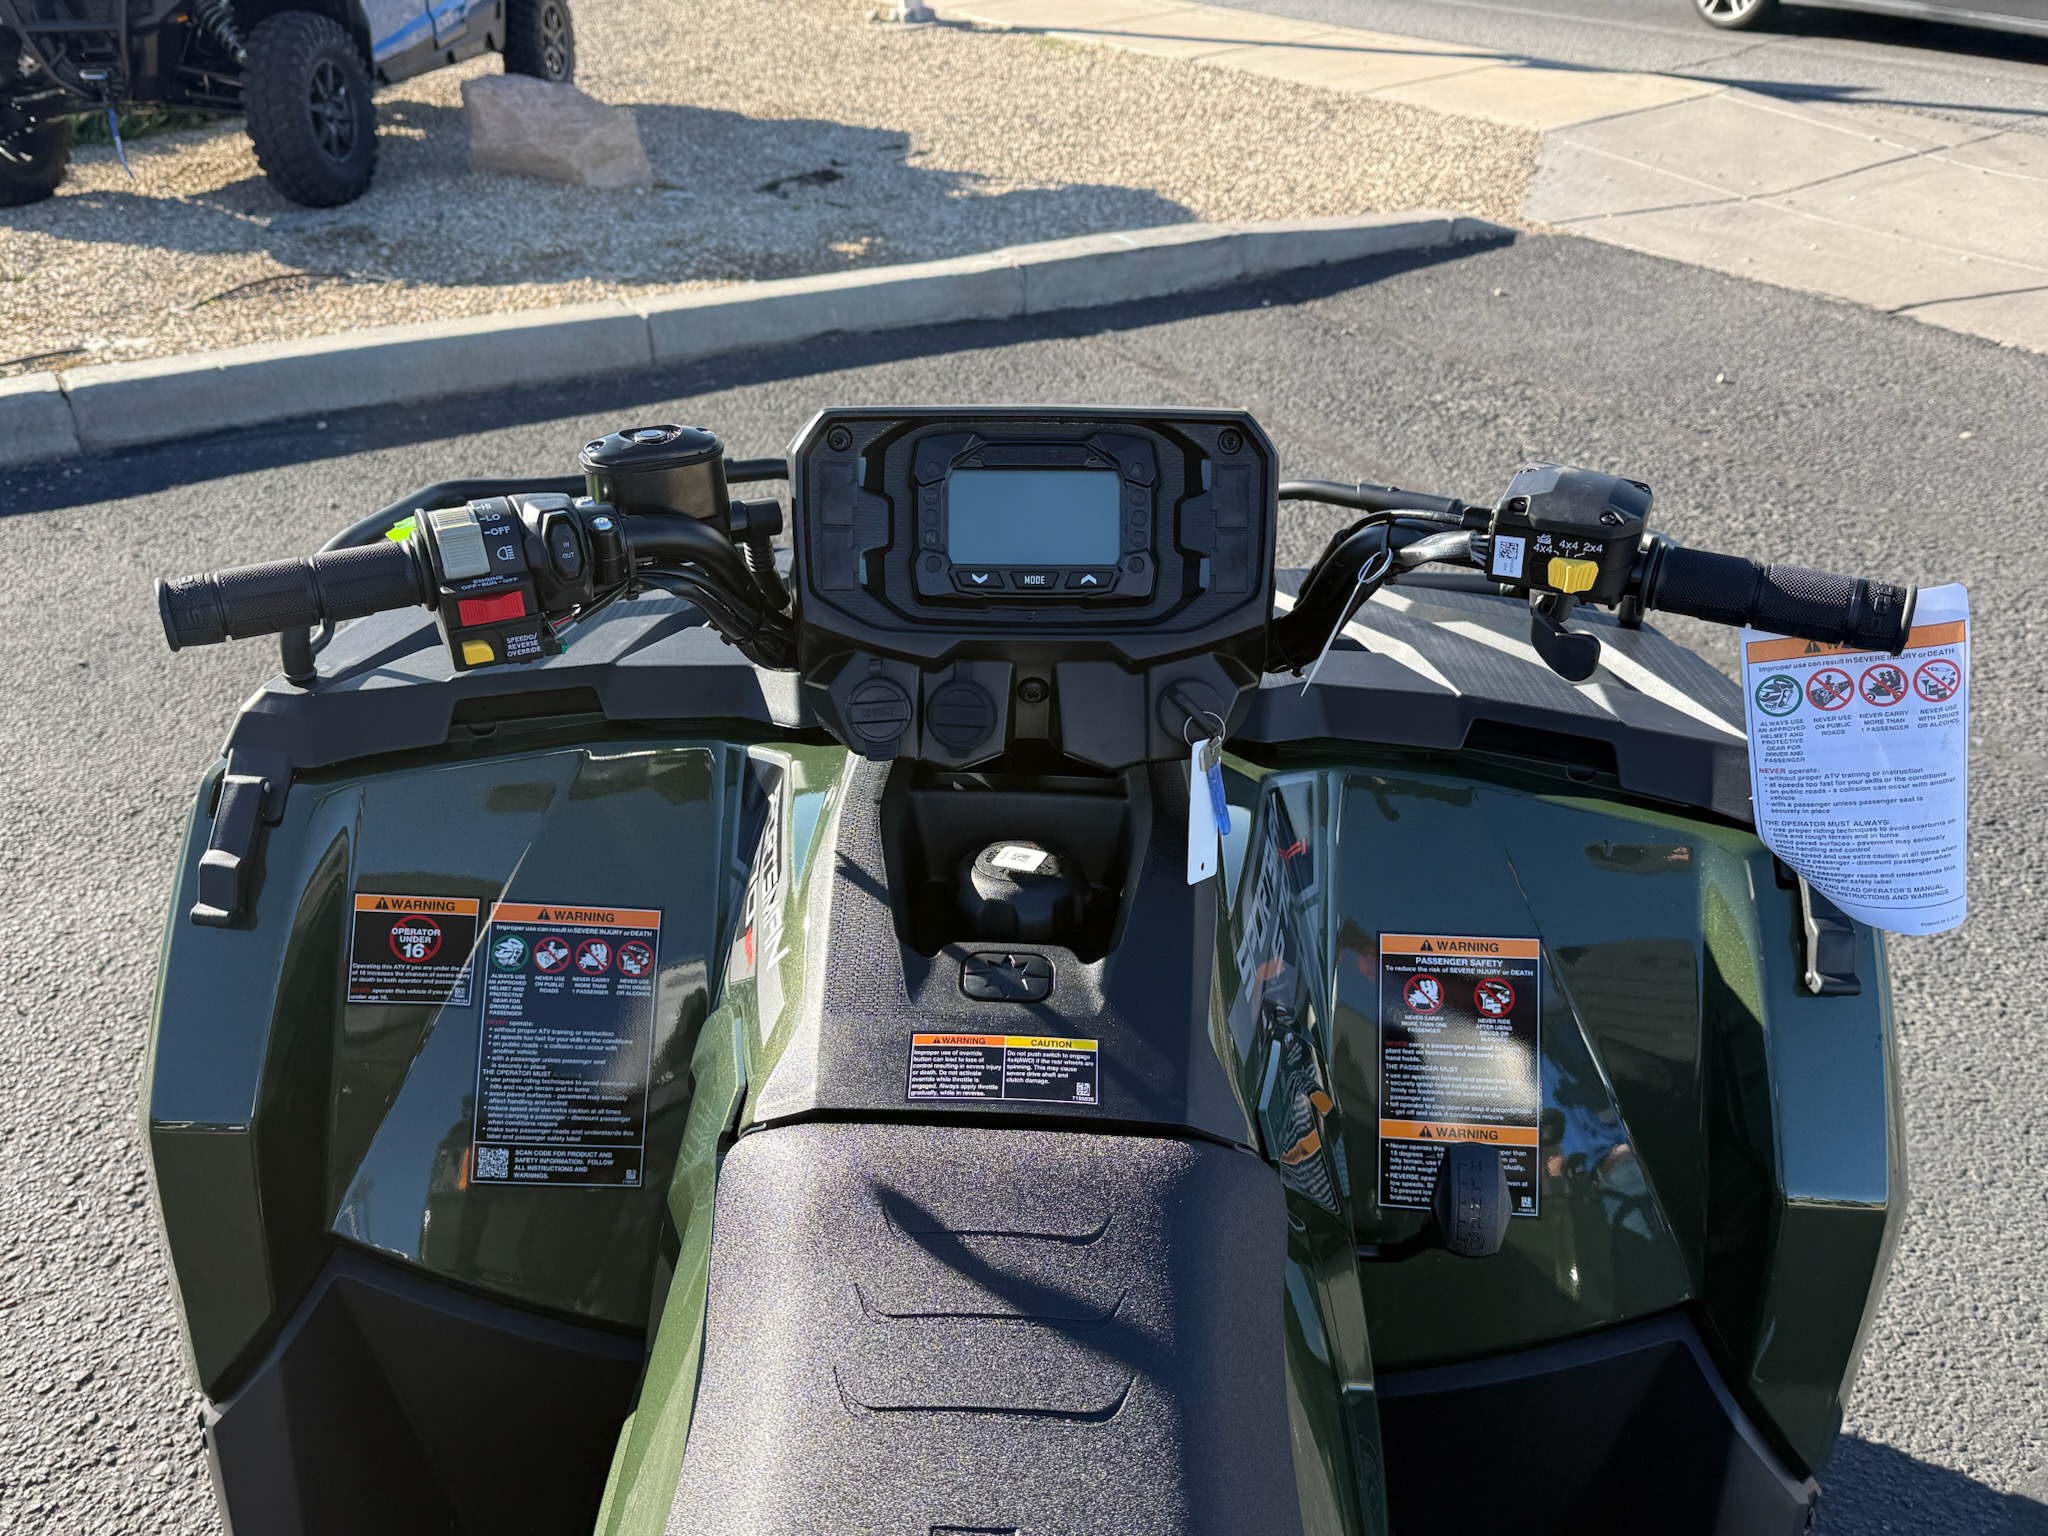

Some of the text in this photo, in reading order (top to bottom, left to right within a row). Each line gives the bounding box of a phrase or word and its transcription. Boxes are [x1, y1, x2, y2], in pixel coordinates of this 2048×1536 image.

[1533, 543, 1552, 553] 4x4
[1559, 540, 1578, 550] 4x4
[1583, 542, 1603, 553] 2x4
[473, 575, 504, 584] ENGINE
[1025, 575, 1045, 584] MODE
[507, 632, 537, 644] SPEEDO/
[508, 640, 538, 650] REVERSE
[507, 646, 541, 657] OVERRIDE
[1759, 664, 1791, 672] Improper
[1853, 655, 1885, 663] SEVERE
[1927, 648, 1954, 657] DEATH
[1937, 710, 1959, 720] DRUGS
[1929, 718, 1960, 727] ALCOHOL
[1769, 725, 1806, 733] APPROVED
[1866, 724, 1909, 732] PASSENGER
[1853, 819, 1890, 827] ALWAYS:
[391, 899, 455, 911] WARNING
[554, 910, 615, 923] WARNING
[391, 927, 441, 936] OPERATOR
[400, 935, 431, 943] UNDER
[403, 944, 425, 958] 16
[1437, 941, 1499, 953] WARNING
[1415, 957, 1468, 967] PASSENGER
[1031, 1040, 1072, 1048] CAUTION
[1436, 1127, 1498, 1140] WARNING
